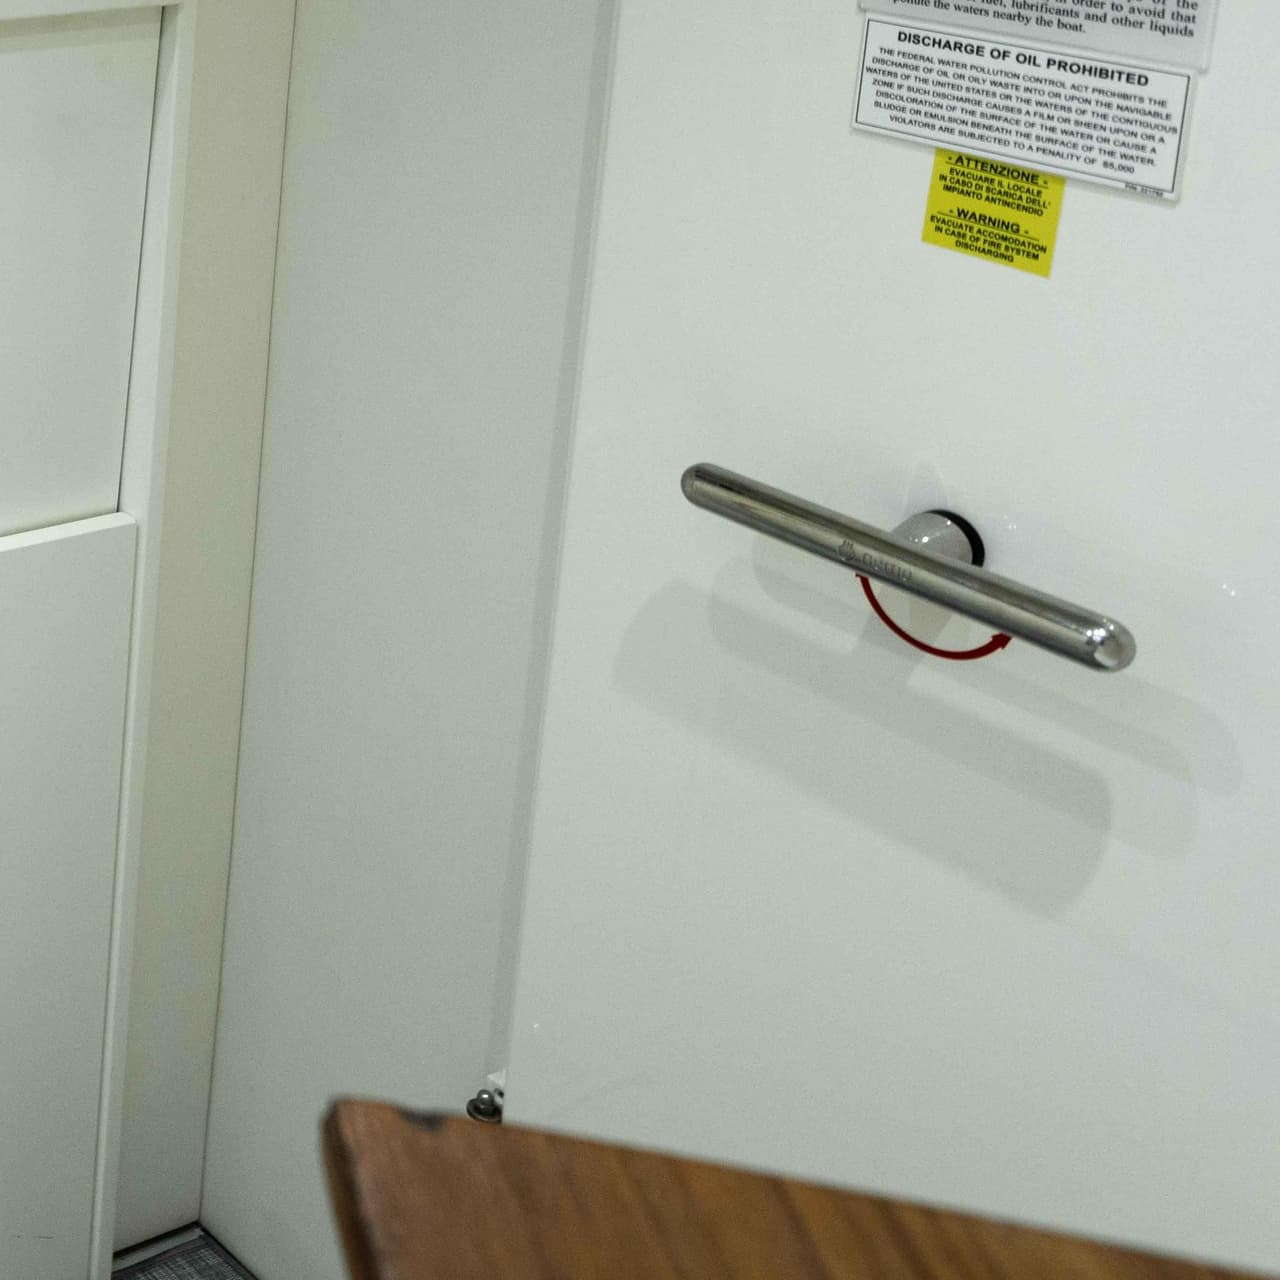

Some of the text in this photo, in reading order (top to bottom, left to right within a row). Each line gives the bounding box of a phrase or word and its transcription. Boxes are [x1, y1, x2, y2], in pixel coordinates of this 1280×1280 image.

[952, 1, 990, 17] waters
[991, 7, 1032, 27] nearby
[1034, 15, 1054, 28] the
[1055, 18, 1087, 34] boat.
[1083, 9, 1107, 24] and
[1110, 14, 1144, 30] other
[1148, 20, 1195, 41] liquids
[1109, 0, 1124, 13] to
[1127, 3, 1166, 20] avoid
[1169, 10, 1197, 25] that
[896, 30, 1149, 88] DISCHARGE OF OIL PROHIBITED
[871, 56, 1172, 122] DISCHARGE OF OIL OR OILY WASTE INTO OR UPON THE NAVIGABLE
[878, 46, 1168, 109] THE FEDERAL WATER POLLUTION CONTROL ACT PROHIBITS THE
[948, 167, 1043, 198] EVACUARE IL LOCALE
[954, 154, 1040, 185] ATTENZIONE
[937, 173, 1051, 209] IN CASO DI SCARICA DELL'
[942, 183, 1044, 217] IMPIANTO ANTINCENDIO
[929, 213, 1047, 254] EVACUATE ACCOMODATION
[955, 207, 1021, 234] WARNING
[933, 224, 1040, 261] IN CASE OF FIRE SYSTEM
[954, 238, 1015, 263] DISCHARGING
